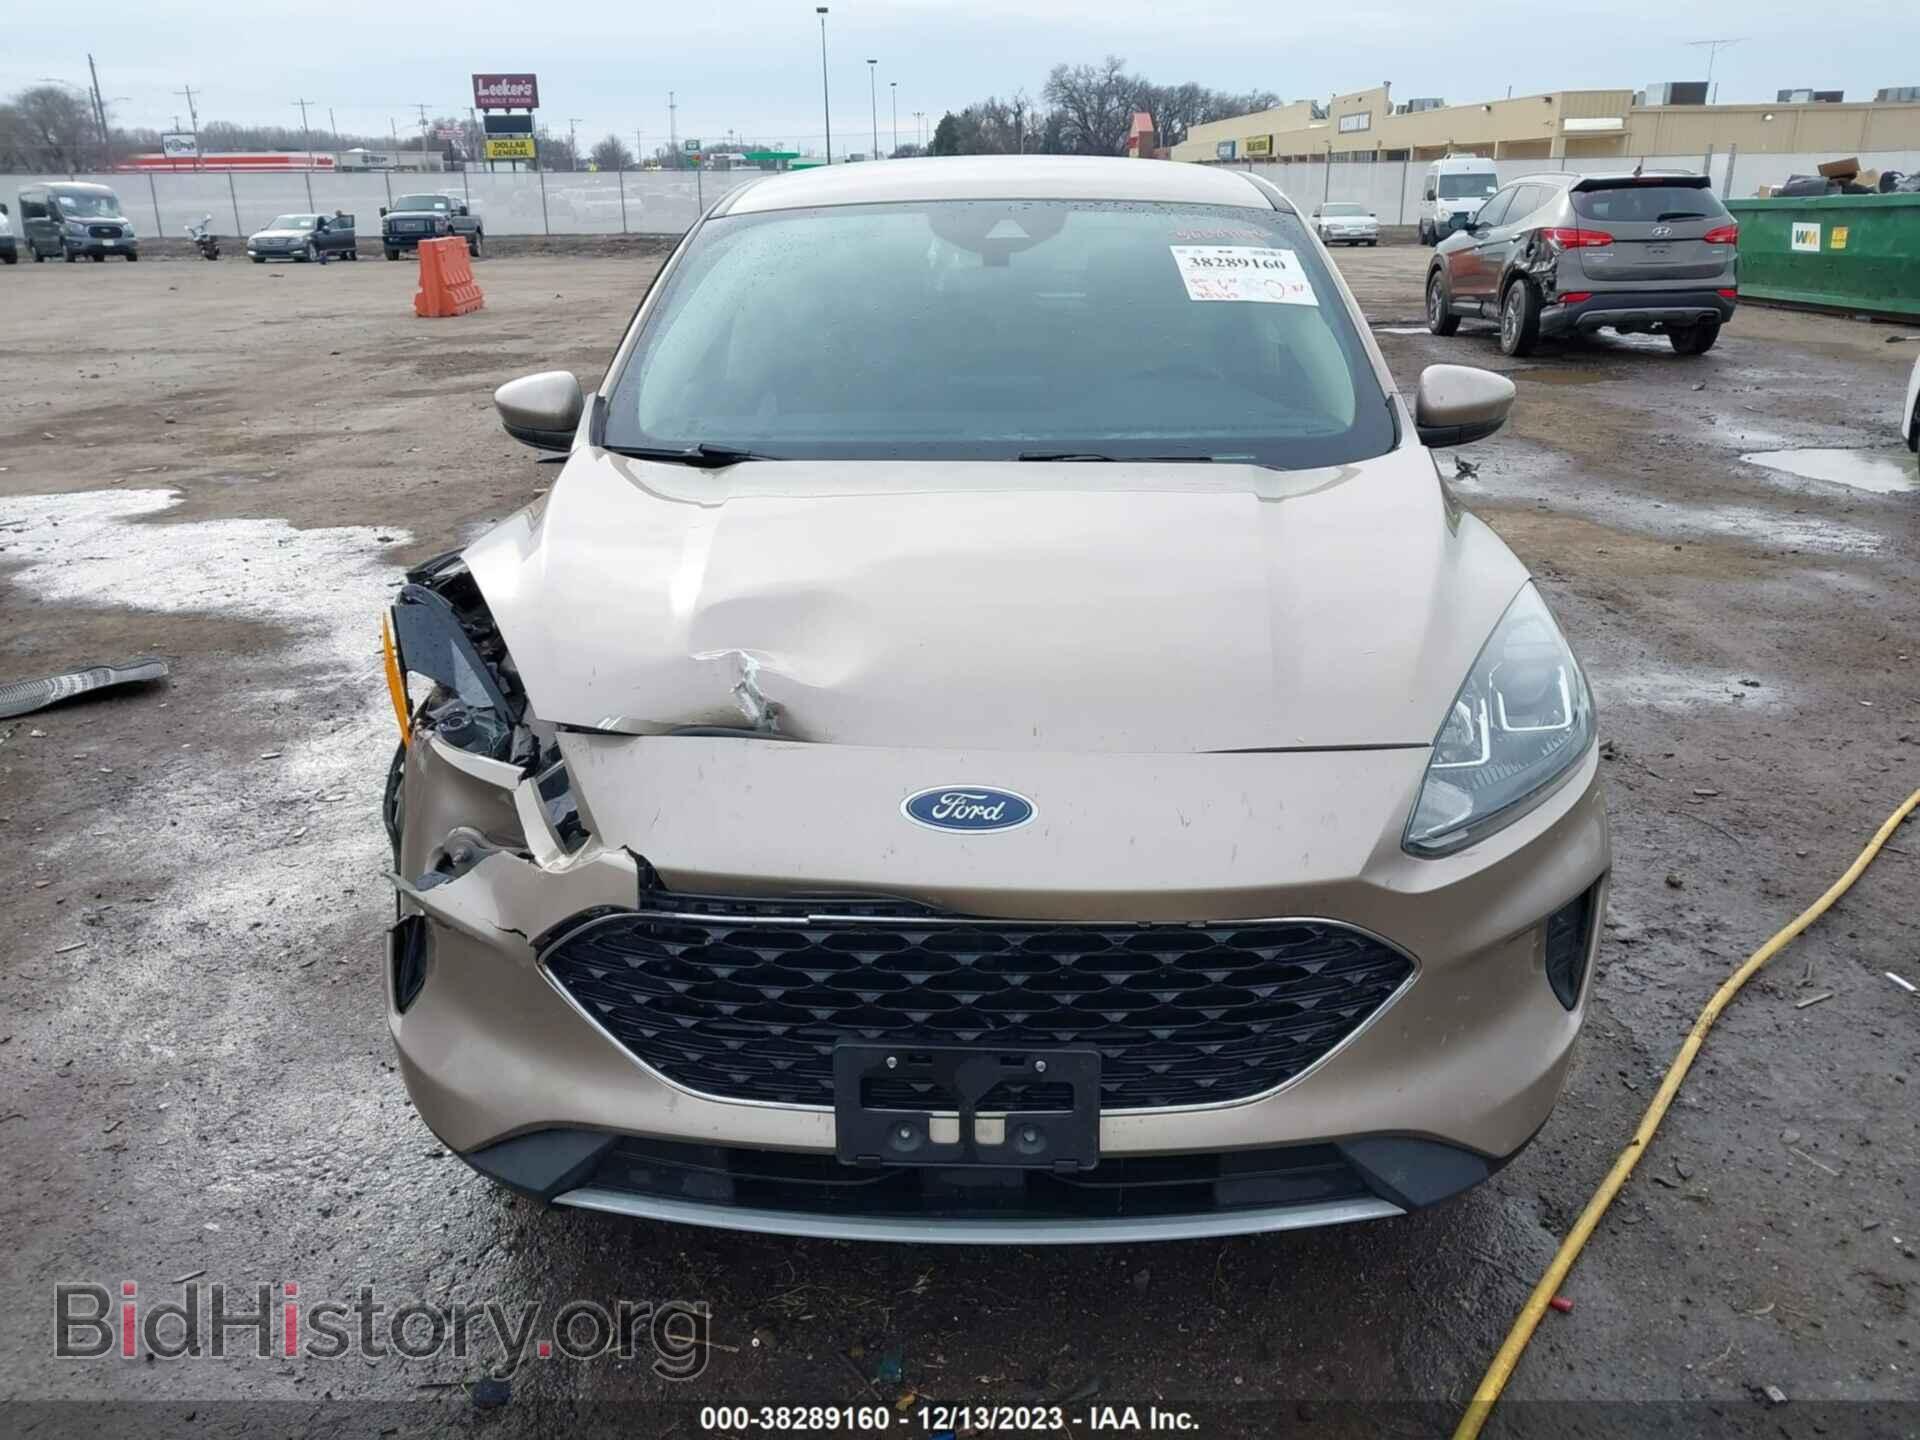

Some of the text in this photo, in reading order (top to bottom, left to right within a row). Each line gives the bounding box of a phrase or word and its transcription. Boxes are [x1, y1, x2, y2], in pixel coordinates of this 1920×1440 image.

[478, 78, 532, 96] Leeker's
[1795, 230, 1817, 244] WM
[1189, 257, 1286, 270] 38289160
[932, 792, 1006, 820] Ford
